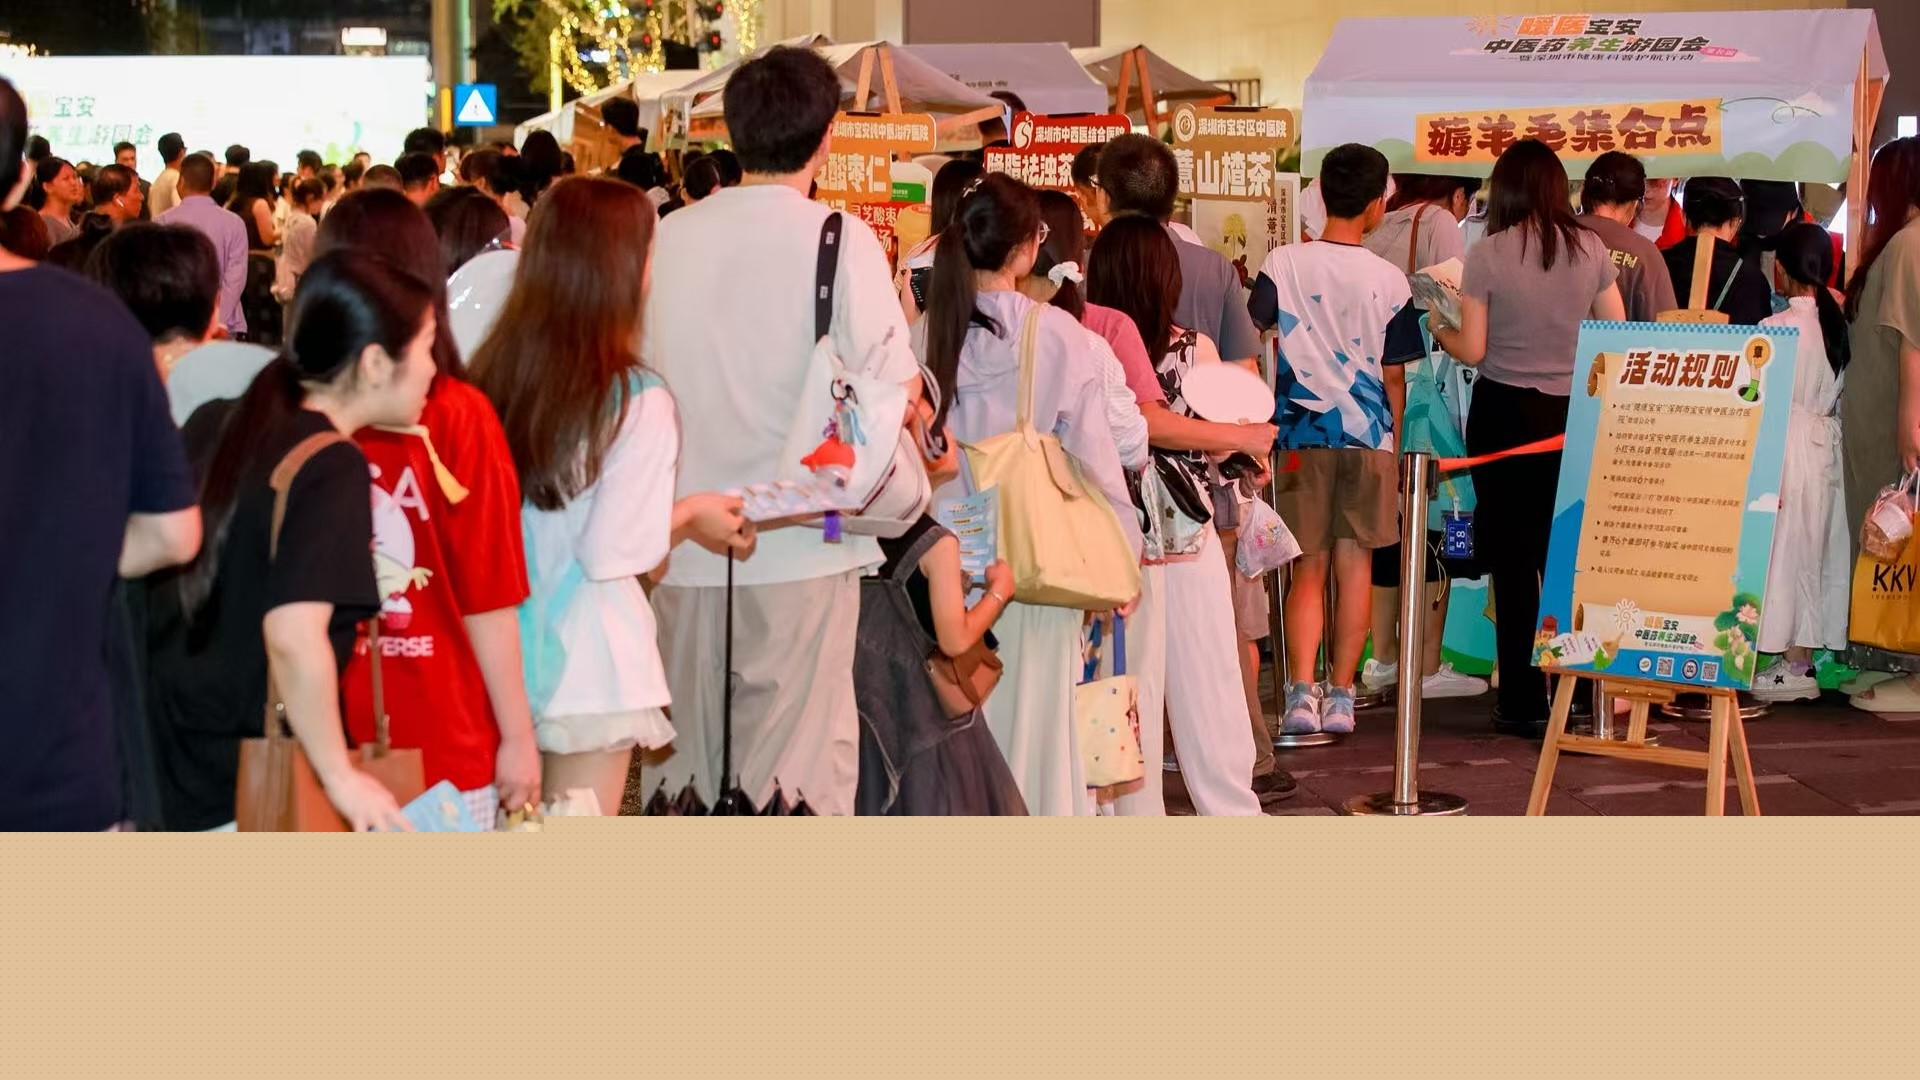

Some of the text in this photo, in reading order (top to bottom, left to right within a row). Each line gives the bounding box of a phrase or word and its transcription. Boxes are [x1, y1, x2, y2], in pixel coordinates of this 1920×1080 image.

[1516, 14, 1642, 36] 暖医宝安
[1483, 36, 1711, 53] 中医药养生游园会
[1197, 118, 1287, 138] 深圳市宝安区中医院
[1427, 104, 1712, 156] 薅羊毛集合点
[986, 153, 1075, 187] 降脂祛浊茶
[1173, 148, 1272, 197] 薏山楂茶
[851, 203, 902, 227] 芝酸枣
[1619, 350, 1741, 389] 活动规则
[1455, 530, 1466, 549] 58
[1872, 563, 1919, 592] KKV
[355, 634, 434, 657] VERSE
